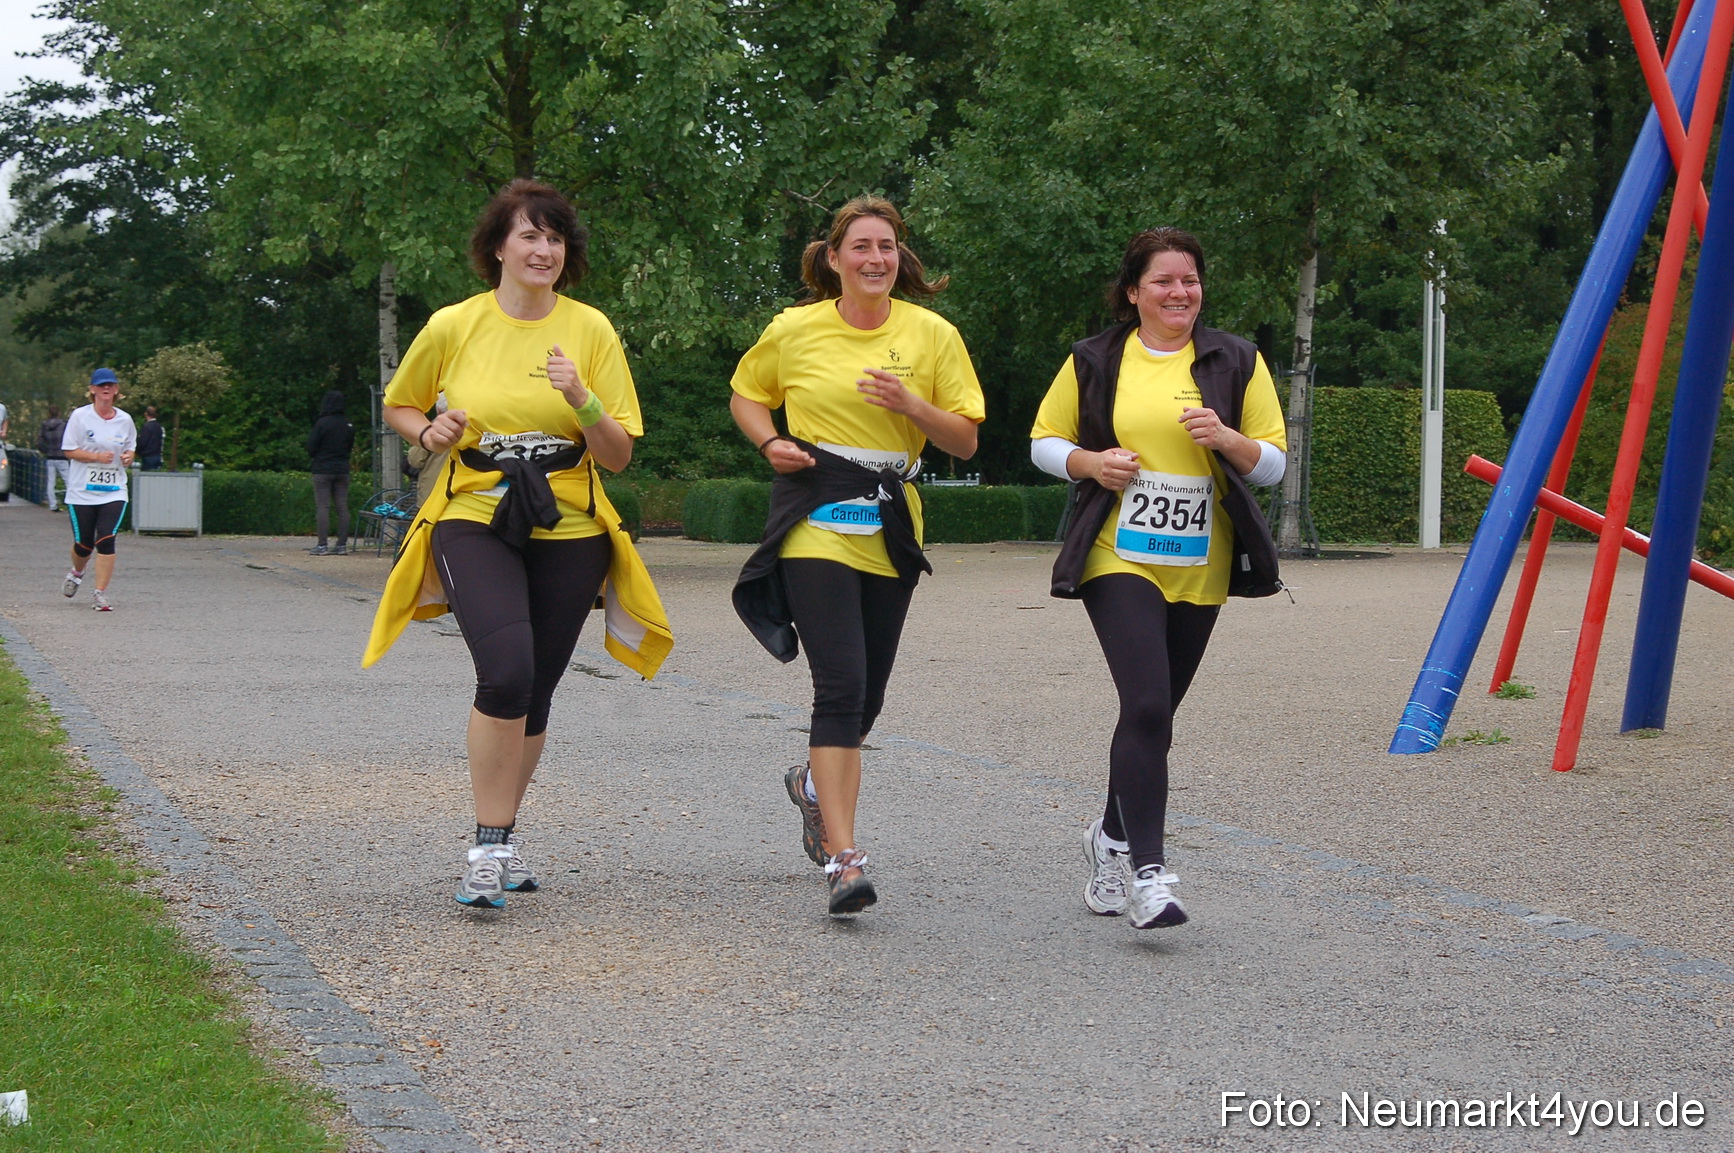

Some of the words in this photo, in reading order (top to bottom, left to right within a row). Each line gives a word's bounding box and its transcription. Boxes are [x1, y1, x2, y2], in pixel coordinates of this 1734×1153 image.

[850, 457, 893, 468] Neumarkt
[90, 471, 116, 484] 2431
[1129, 478, 1157, 490] PARTL
[1161, 483, 1204, 494] Neumarkt
[831, 508, 881, 522] Caroline
[1129, 493, 1207, 531] 2354
[1148, 538, 1181, 553] Britta
